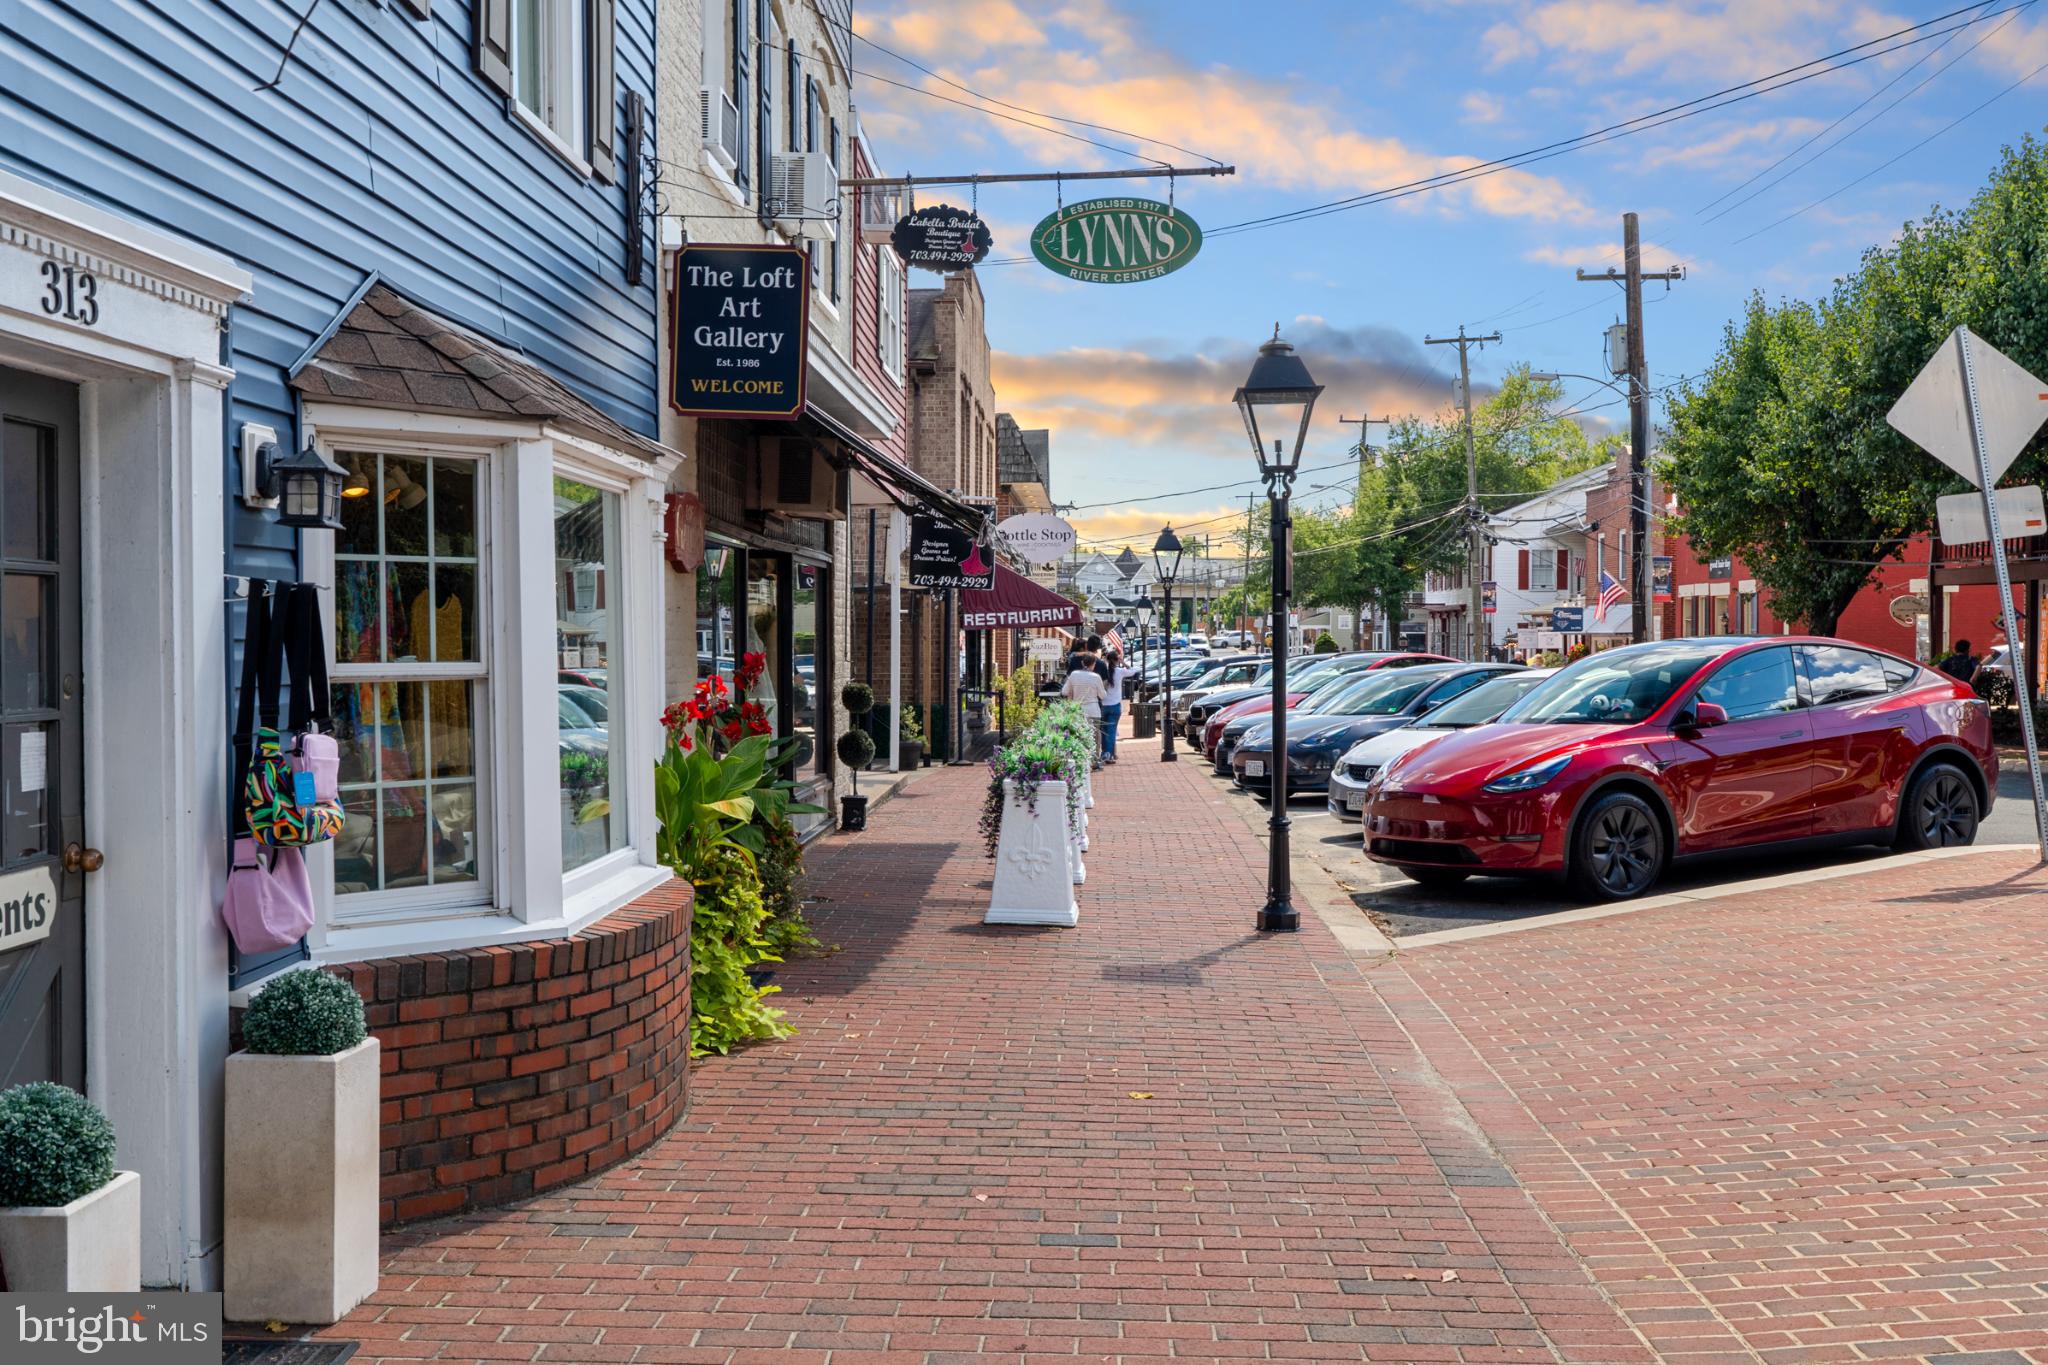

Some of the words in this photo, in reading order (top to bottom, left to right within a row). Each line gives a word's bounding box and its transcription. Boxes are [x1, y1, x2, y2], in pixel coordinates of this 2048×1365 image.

[1070, 199, 1134, 215] ESTABLISED
[1138, 201, 1161, 212] 1917
[908, 216, 945, 228] Labella
[947, 217, 981, 229] Bridal
[926, 228, 961, 239] Boutique
[1060, 213, 1175, 268] LYNN'S
[687, 265, 734, 287] The
[742, 266, 796, 289] Loft
[1070, 268, 1109, 282] RIVER
[1114, 266, 1166, 282] CENTER
[41, 260, 99, 326] 313
[718, 296, 762, 318] Art
[693, 325, 785, 354] Gallery
[716, 358, 734, 367] Est.
[736, 358, 760, 368] 1986
[690, 378, 785, 395] WELCOME
[1041, 528, 1072, 542] Stop
[921, 547, 941, 555] Gowns
[922, 539, 949, 548] Designer
[914, 574, 988, 588] 703-494-2929
[963, 606, 1074, 626] RESTAURANT
